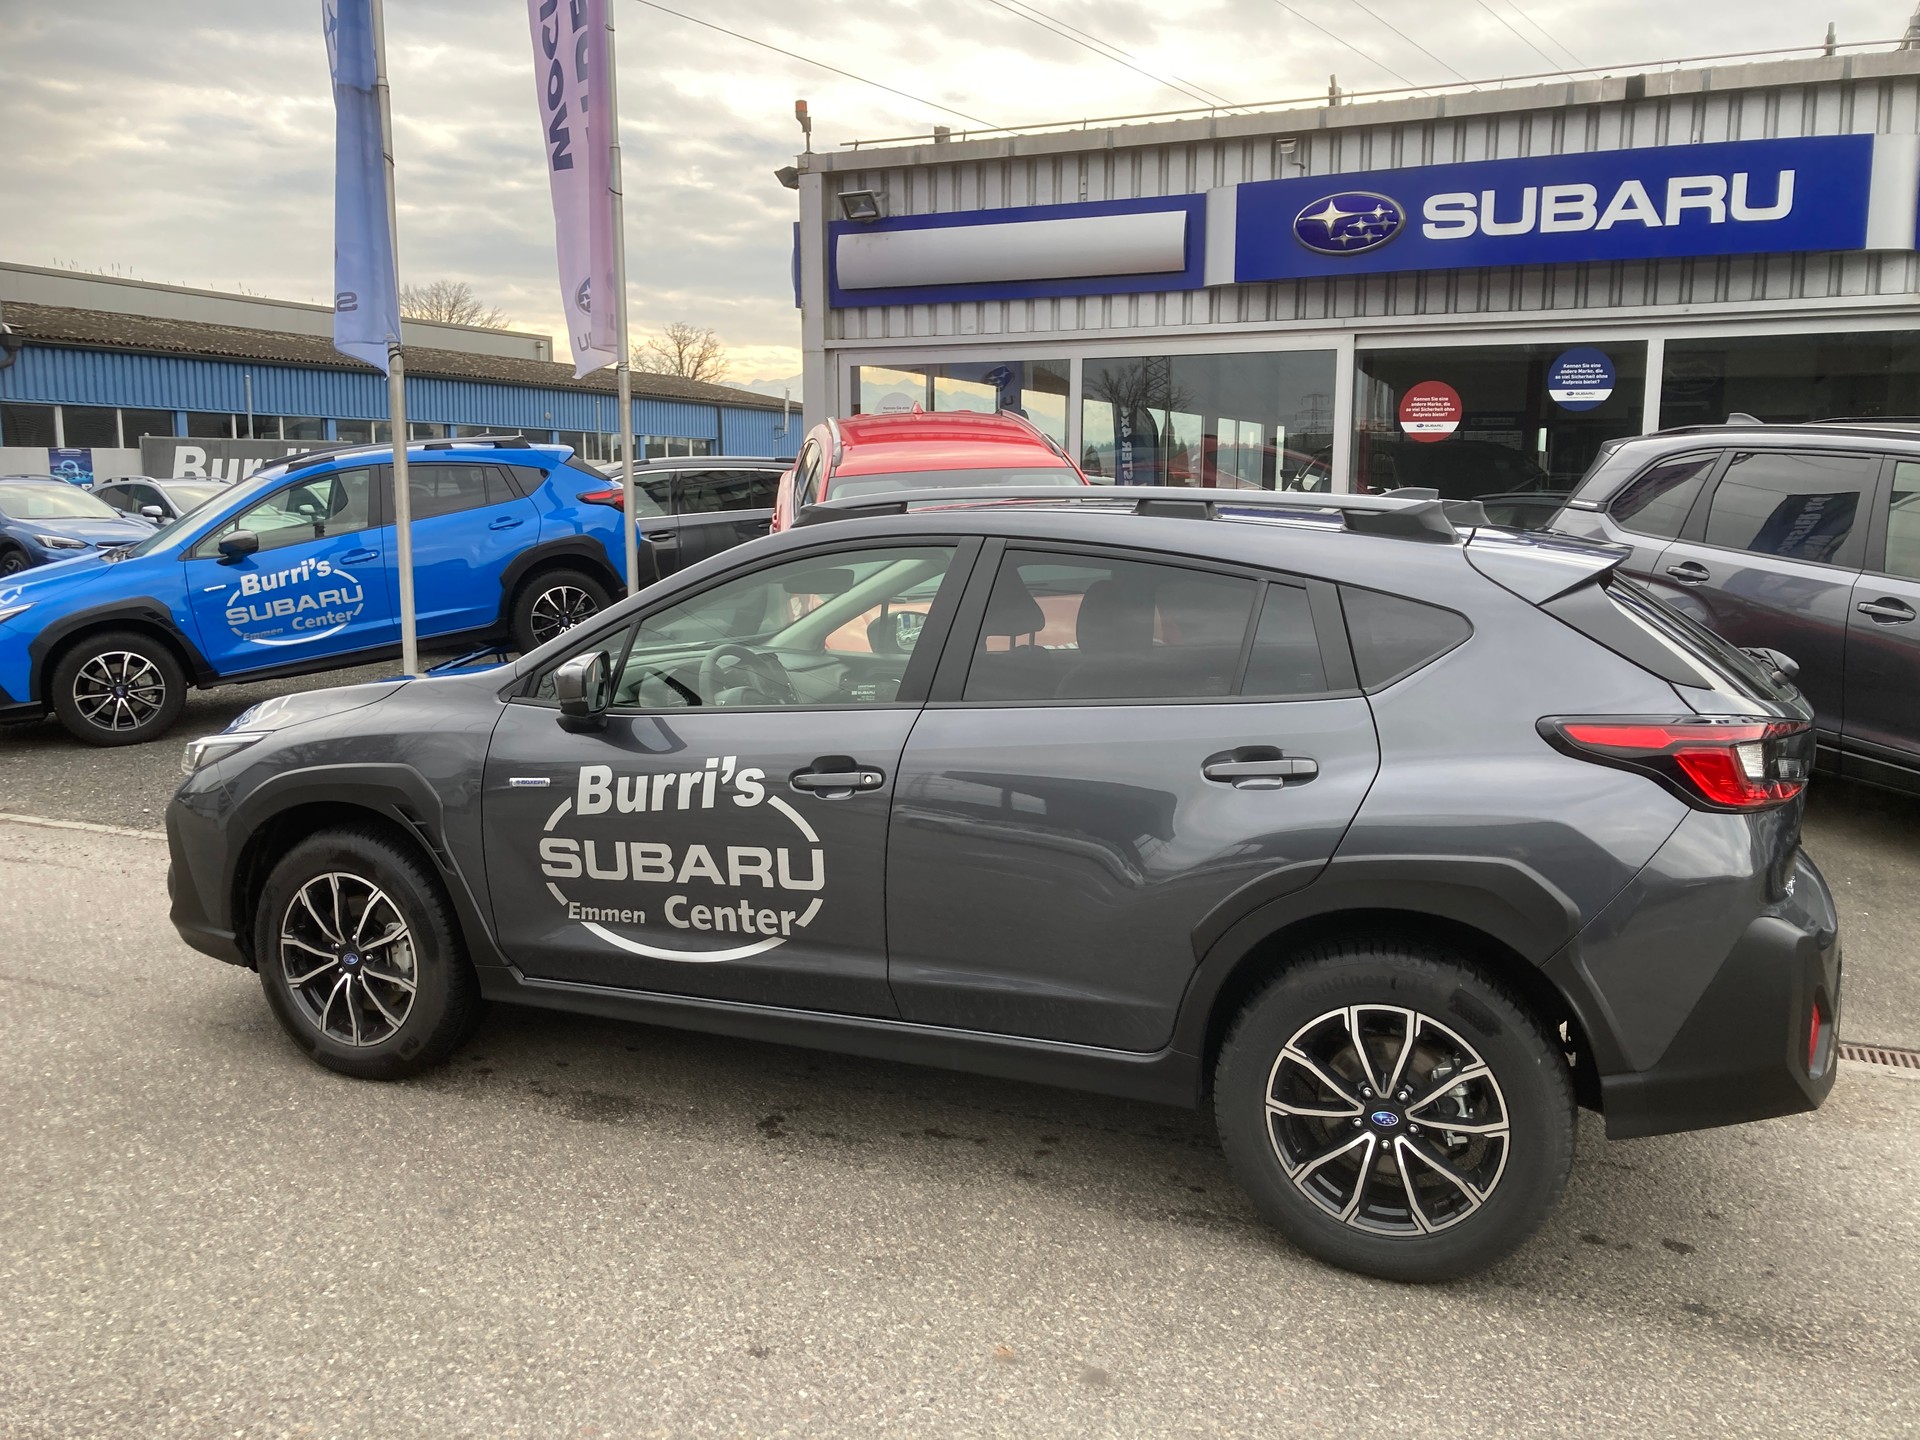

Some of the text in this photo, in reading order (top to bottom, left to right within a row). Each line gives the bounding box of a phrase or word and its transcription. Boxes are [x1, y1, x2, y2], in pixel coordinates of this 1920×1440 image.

[1421, 169, 1796, 241] SUBARU
[240, 557, 332, 597] Burri's
[225, 584, 364, 626] SUBARU
[242, 610, 353, 641] Emmen Center
[576, 755, 766, 816] Burri's
[539, 837, 825, 892] SUBARU
[568, 895, 796, 937] Emmen Center
